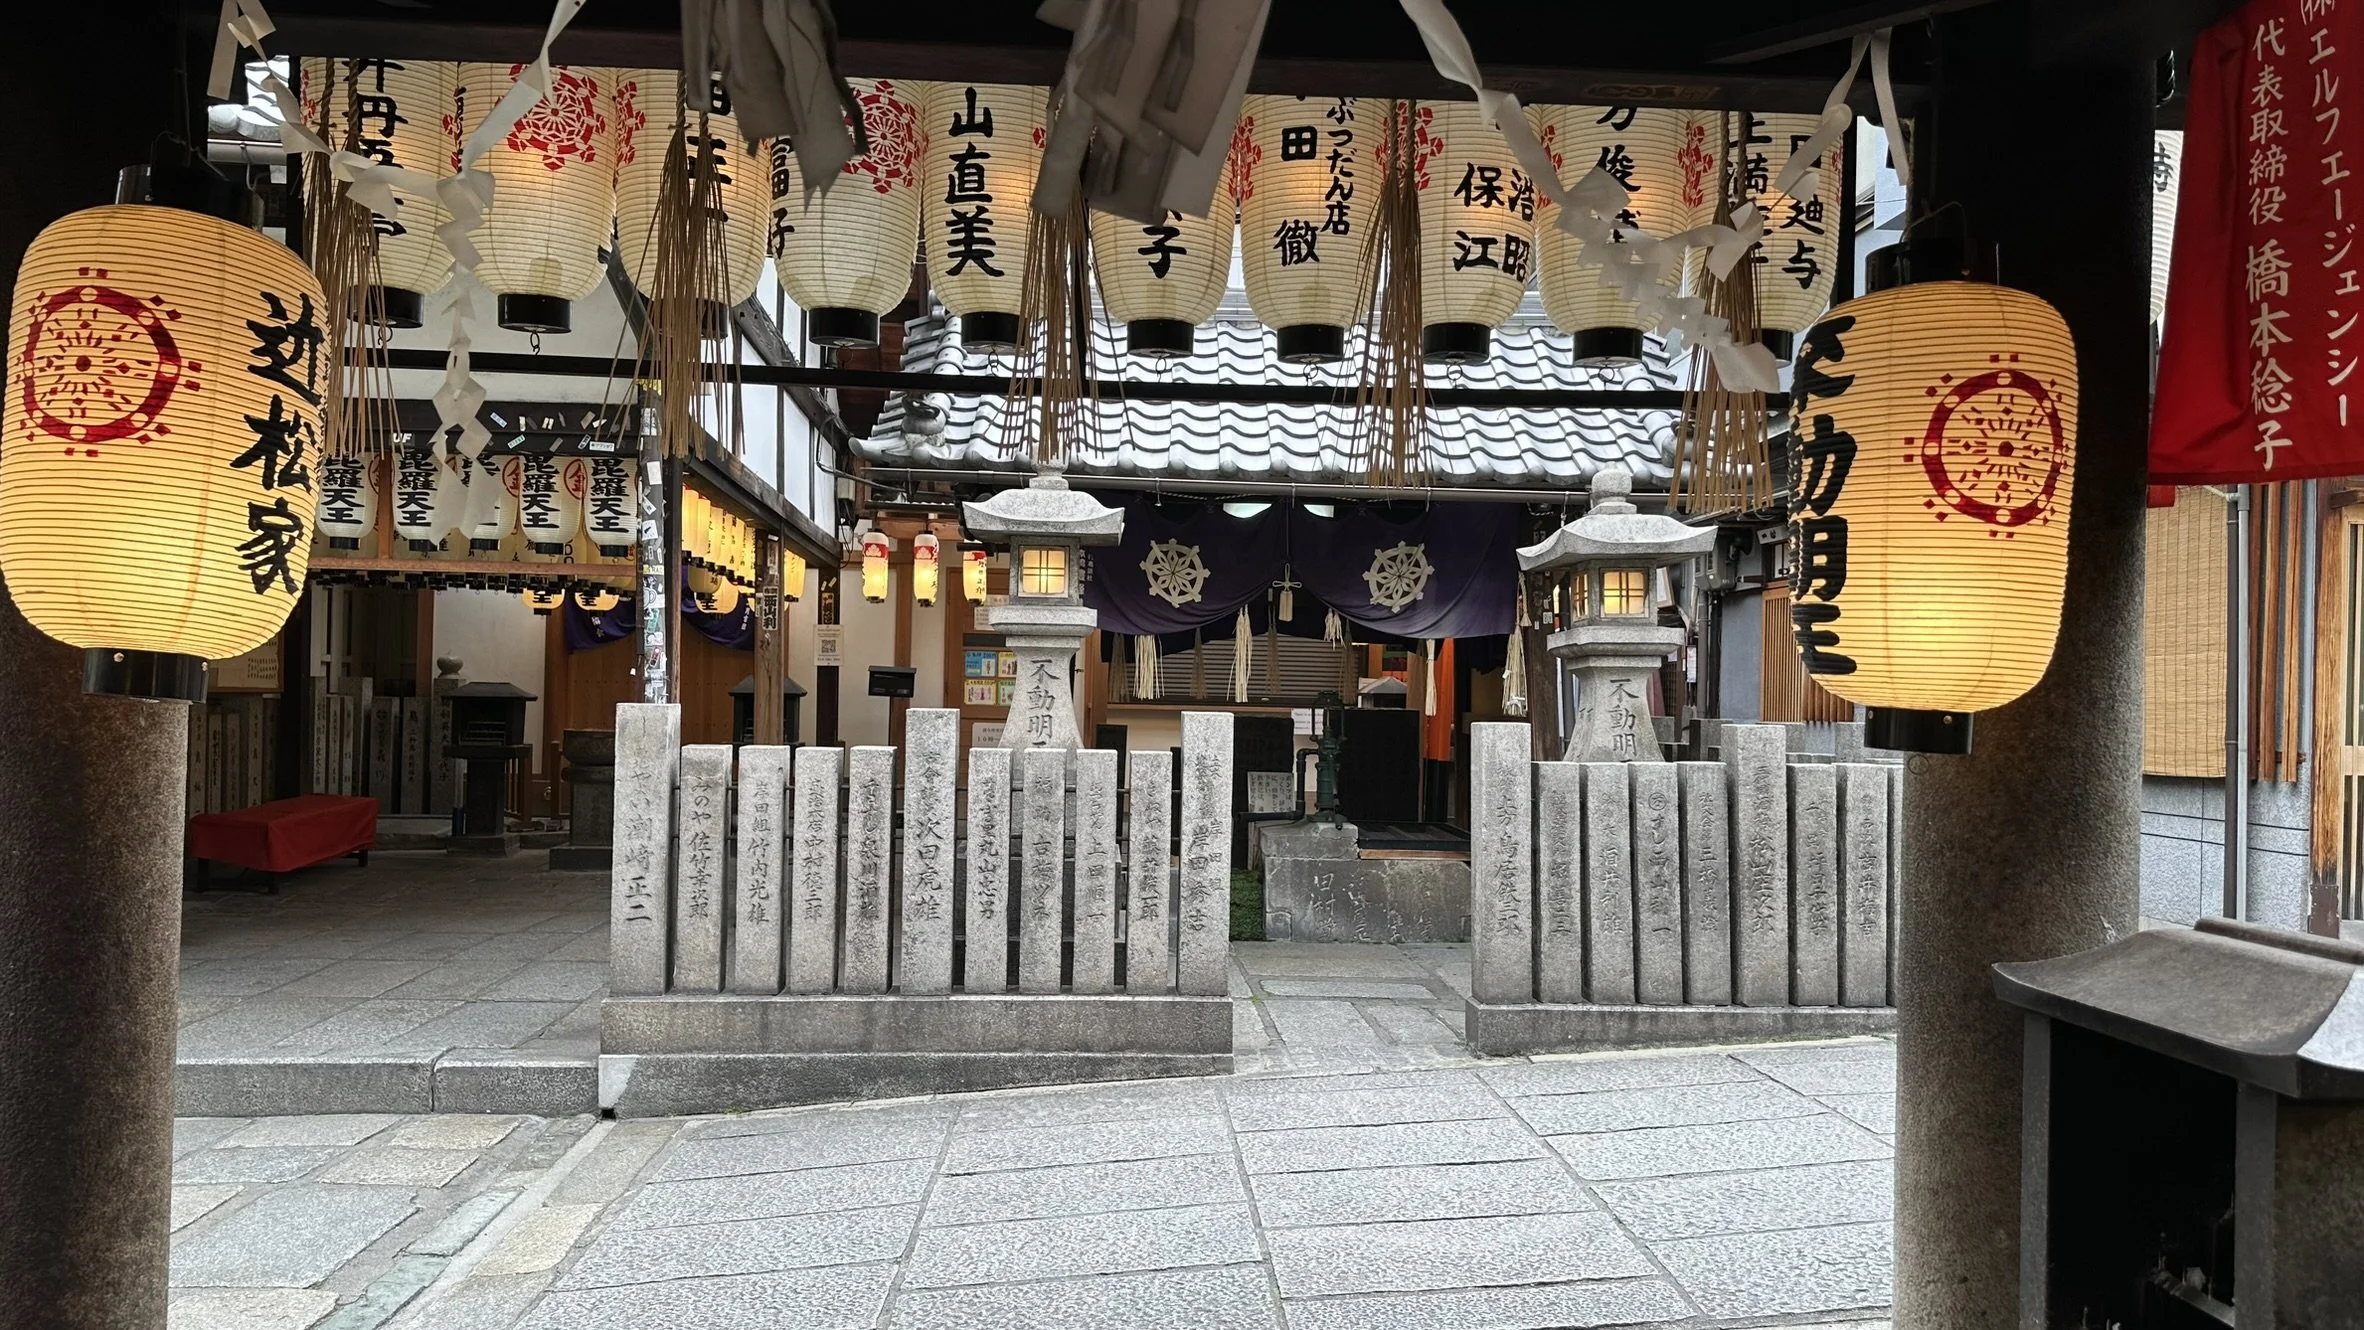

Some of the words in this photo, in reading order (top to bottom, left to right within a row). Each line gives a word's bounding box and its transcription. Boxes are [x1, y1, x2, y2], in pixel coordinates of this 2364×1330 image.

[1321, 97, 1357, 236] ぶつだん店
[2249, 17, 2288, 227] 代表取締役
[945, 86, 1005, 277] 山直美
[1273, 96, 1320, 267] 田徹
[1454, 162, 1505, 272] 保江
[1502, 168, 1536, 282] 浩昭
[1138, 209, 1187, 279] 子
[2246, 238, 2292, 471] 橋本稔子
[397, 450, 439, 527] 毘羅天王
[522, 453, 561, 528] 毘羅天王
[590, 458, 631, 533] 毘羅天王
[1027, 658, 1061, 749] 不動明
[1609, 677, 1639, 762] 不動明
